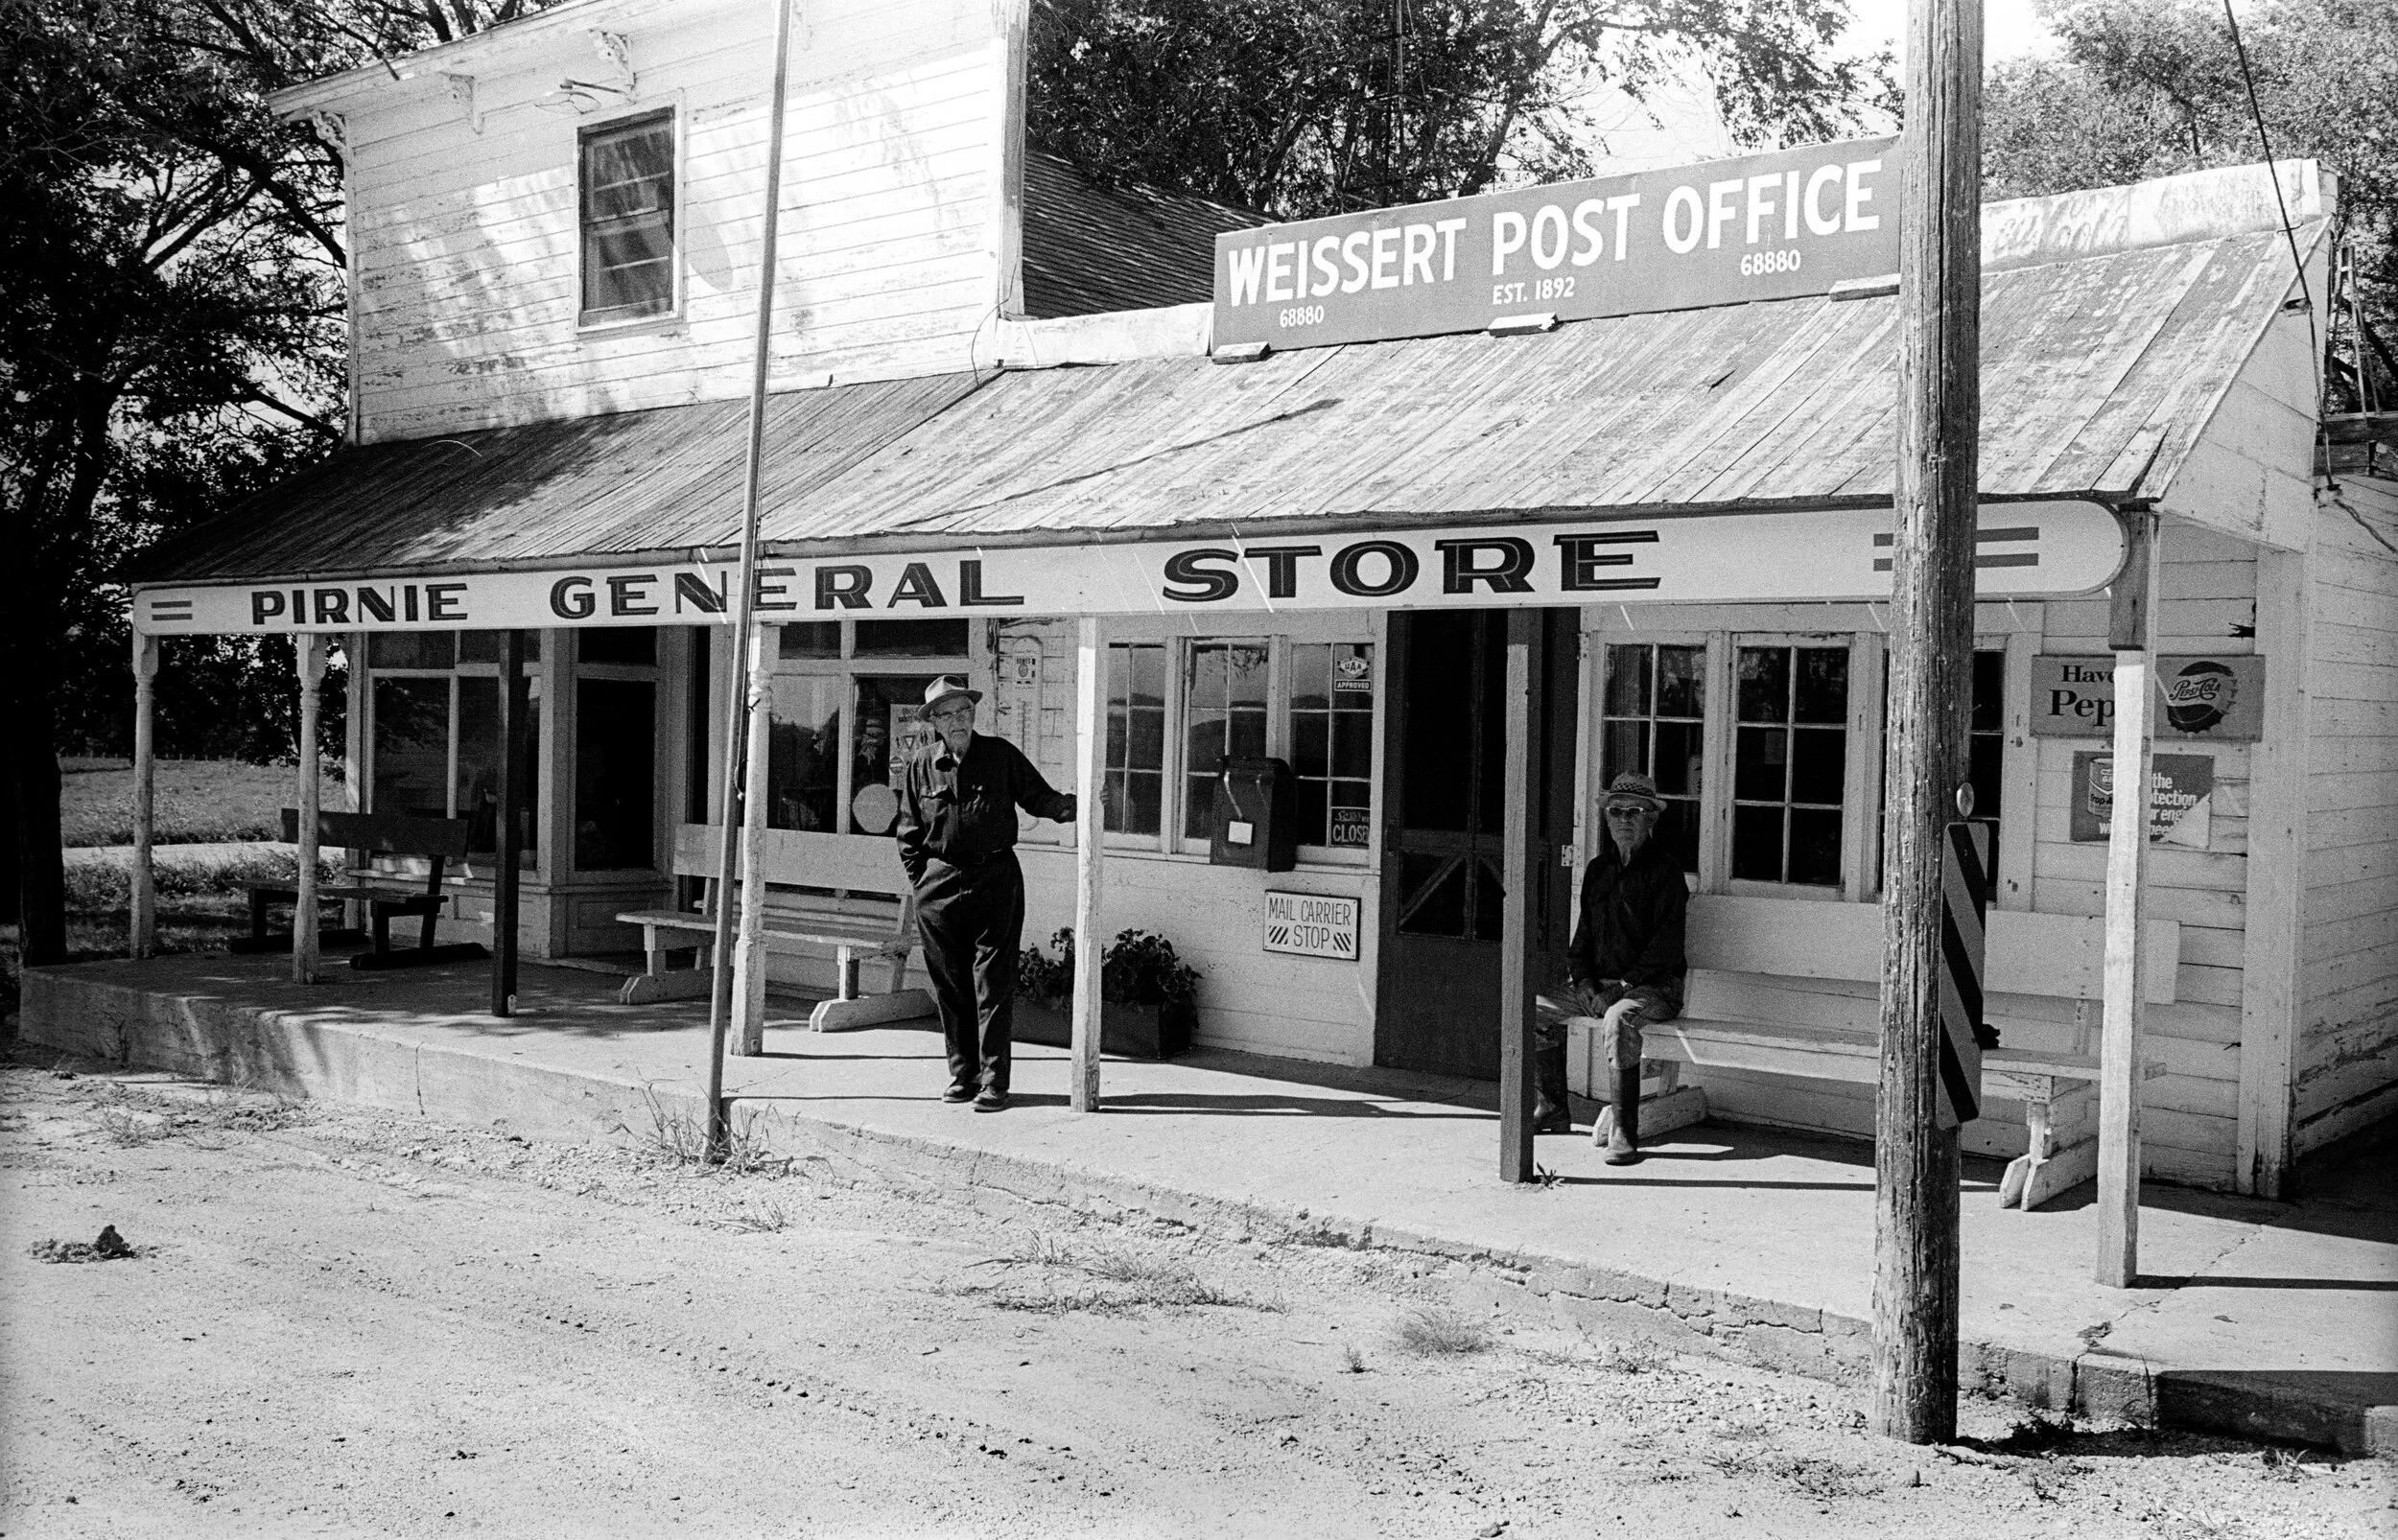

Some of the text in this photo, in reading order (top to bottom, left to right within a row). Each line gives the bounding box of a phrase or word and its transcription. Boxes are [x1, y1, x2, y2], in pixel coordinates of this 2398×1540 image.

[1228, 159, 1881, 307] WEISSERT POST OFFICE
[1740, 249, 1800, 276] 68880
[1493, 276, 1574, 305] EST. 1892
[1280, 305, 1325, 328] 68880
[251, 530, 1661, 625] PIRNIE GENERAL STORE
[2048, 689, 2115, 726] Pep
[2152, 788, 2197, 805] tection
[1333, 824, 1370, 843] CLOSE
[1269, 898, 1351, 925] MAIL CARRIER
[1293, 924, 1329, 949] STOP
